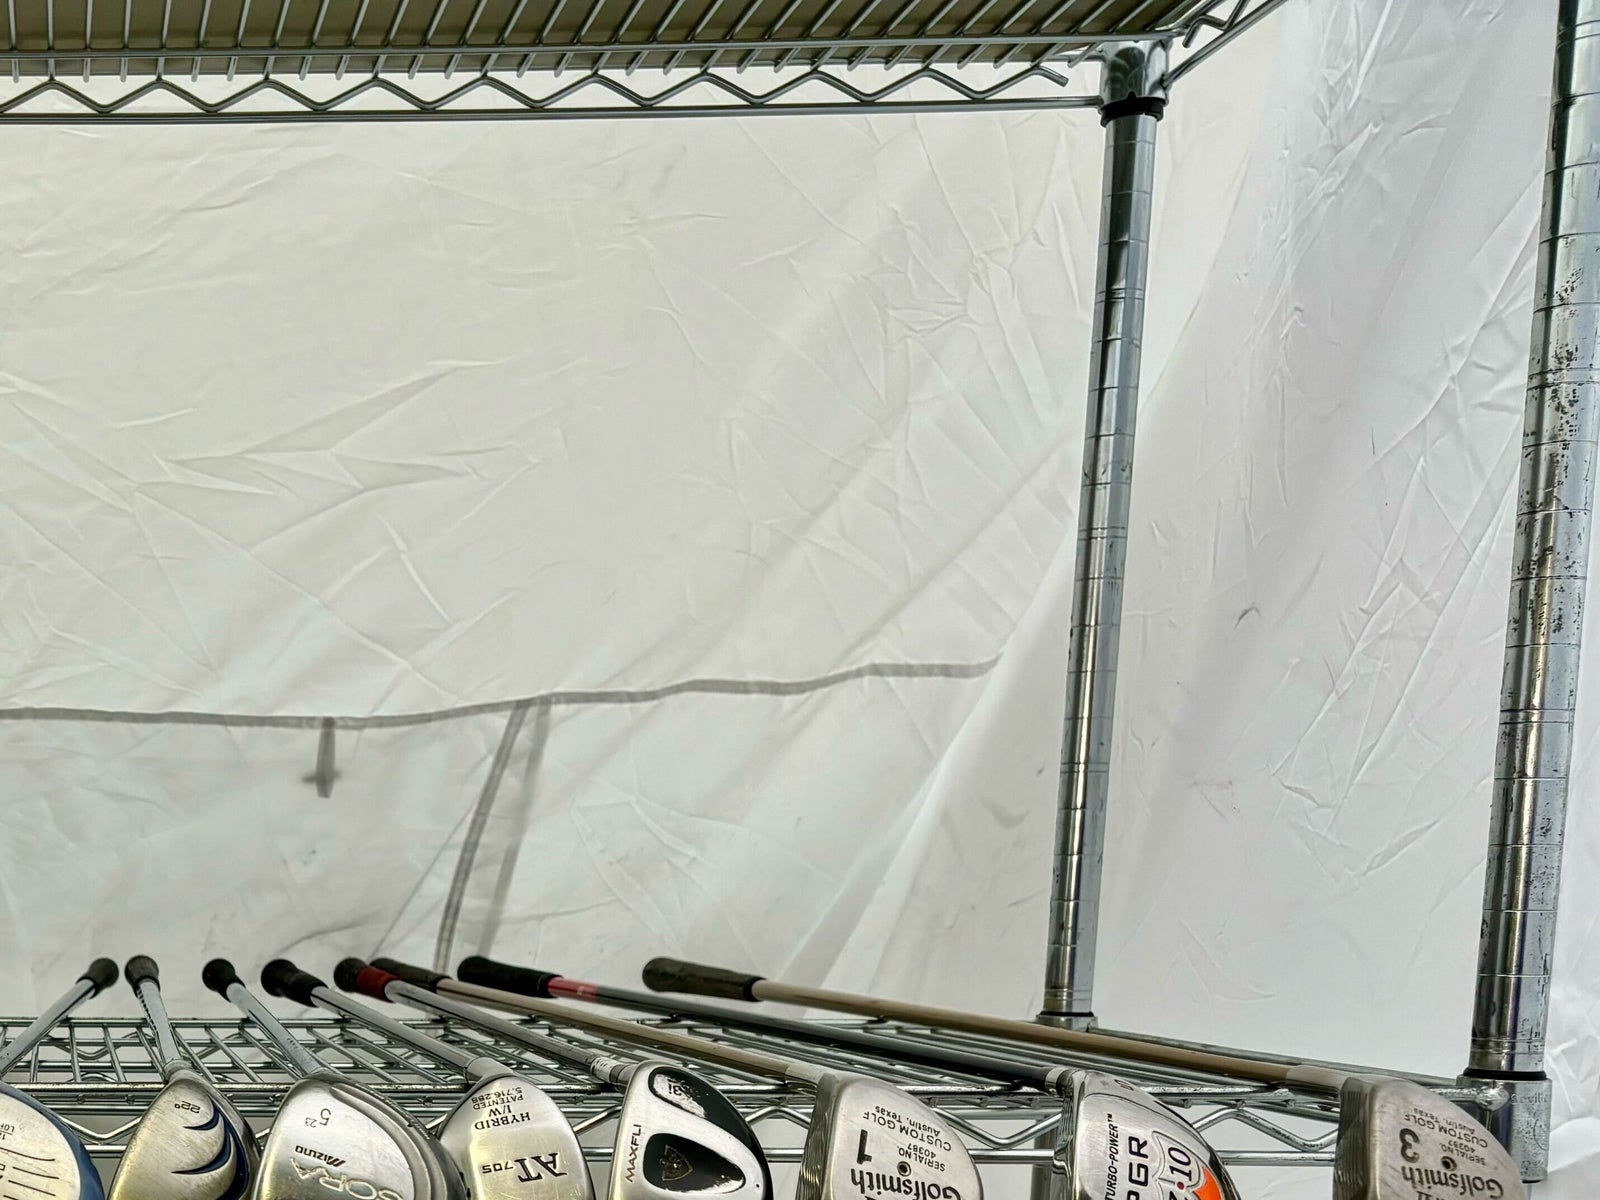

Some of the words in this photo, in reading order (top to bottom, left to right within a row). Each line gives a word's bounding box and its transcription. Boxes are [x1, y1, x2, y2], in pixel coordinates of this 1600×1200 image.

[174, 1100, 200, 1114] 22°
[472, 1094, 524, 1110] PATENTED
[489, 1105, 512, 1117] I/W
[318, 1108, 331, 1127] 5
[474, 1112, 530, 1130] HYBRID
[863, 1111, 896, 1130] GOLF
[875, 1105, 900, 1121] Texas
[1405, 1113, 1435, 1131] GOLF
[898, 1124, 951, 1151] CUSTOM
[1400, 1129, 1419, 1162] 3
[1439, 1125, 1488, 1147] CUSTOM
[626, 1124, 642, 1182] MAXFLI
[857, 1128, 873, 1164] 1
[906, 1144, 937, 1158] 40387
[295, 1145, 345, 1167] MIZUNO
[482, 1162, 514, 1174] 705
[518, 1152, 567, 1182] AT
[1401, 1166, 1503, 1200] Golfsmith
